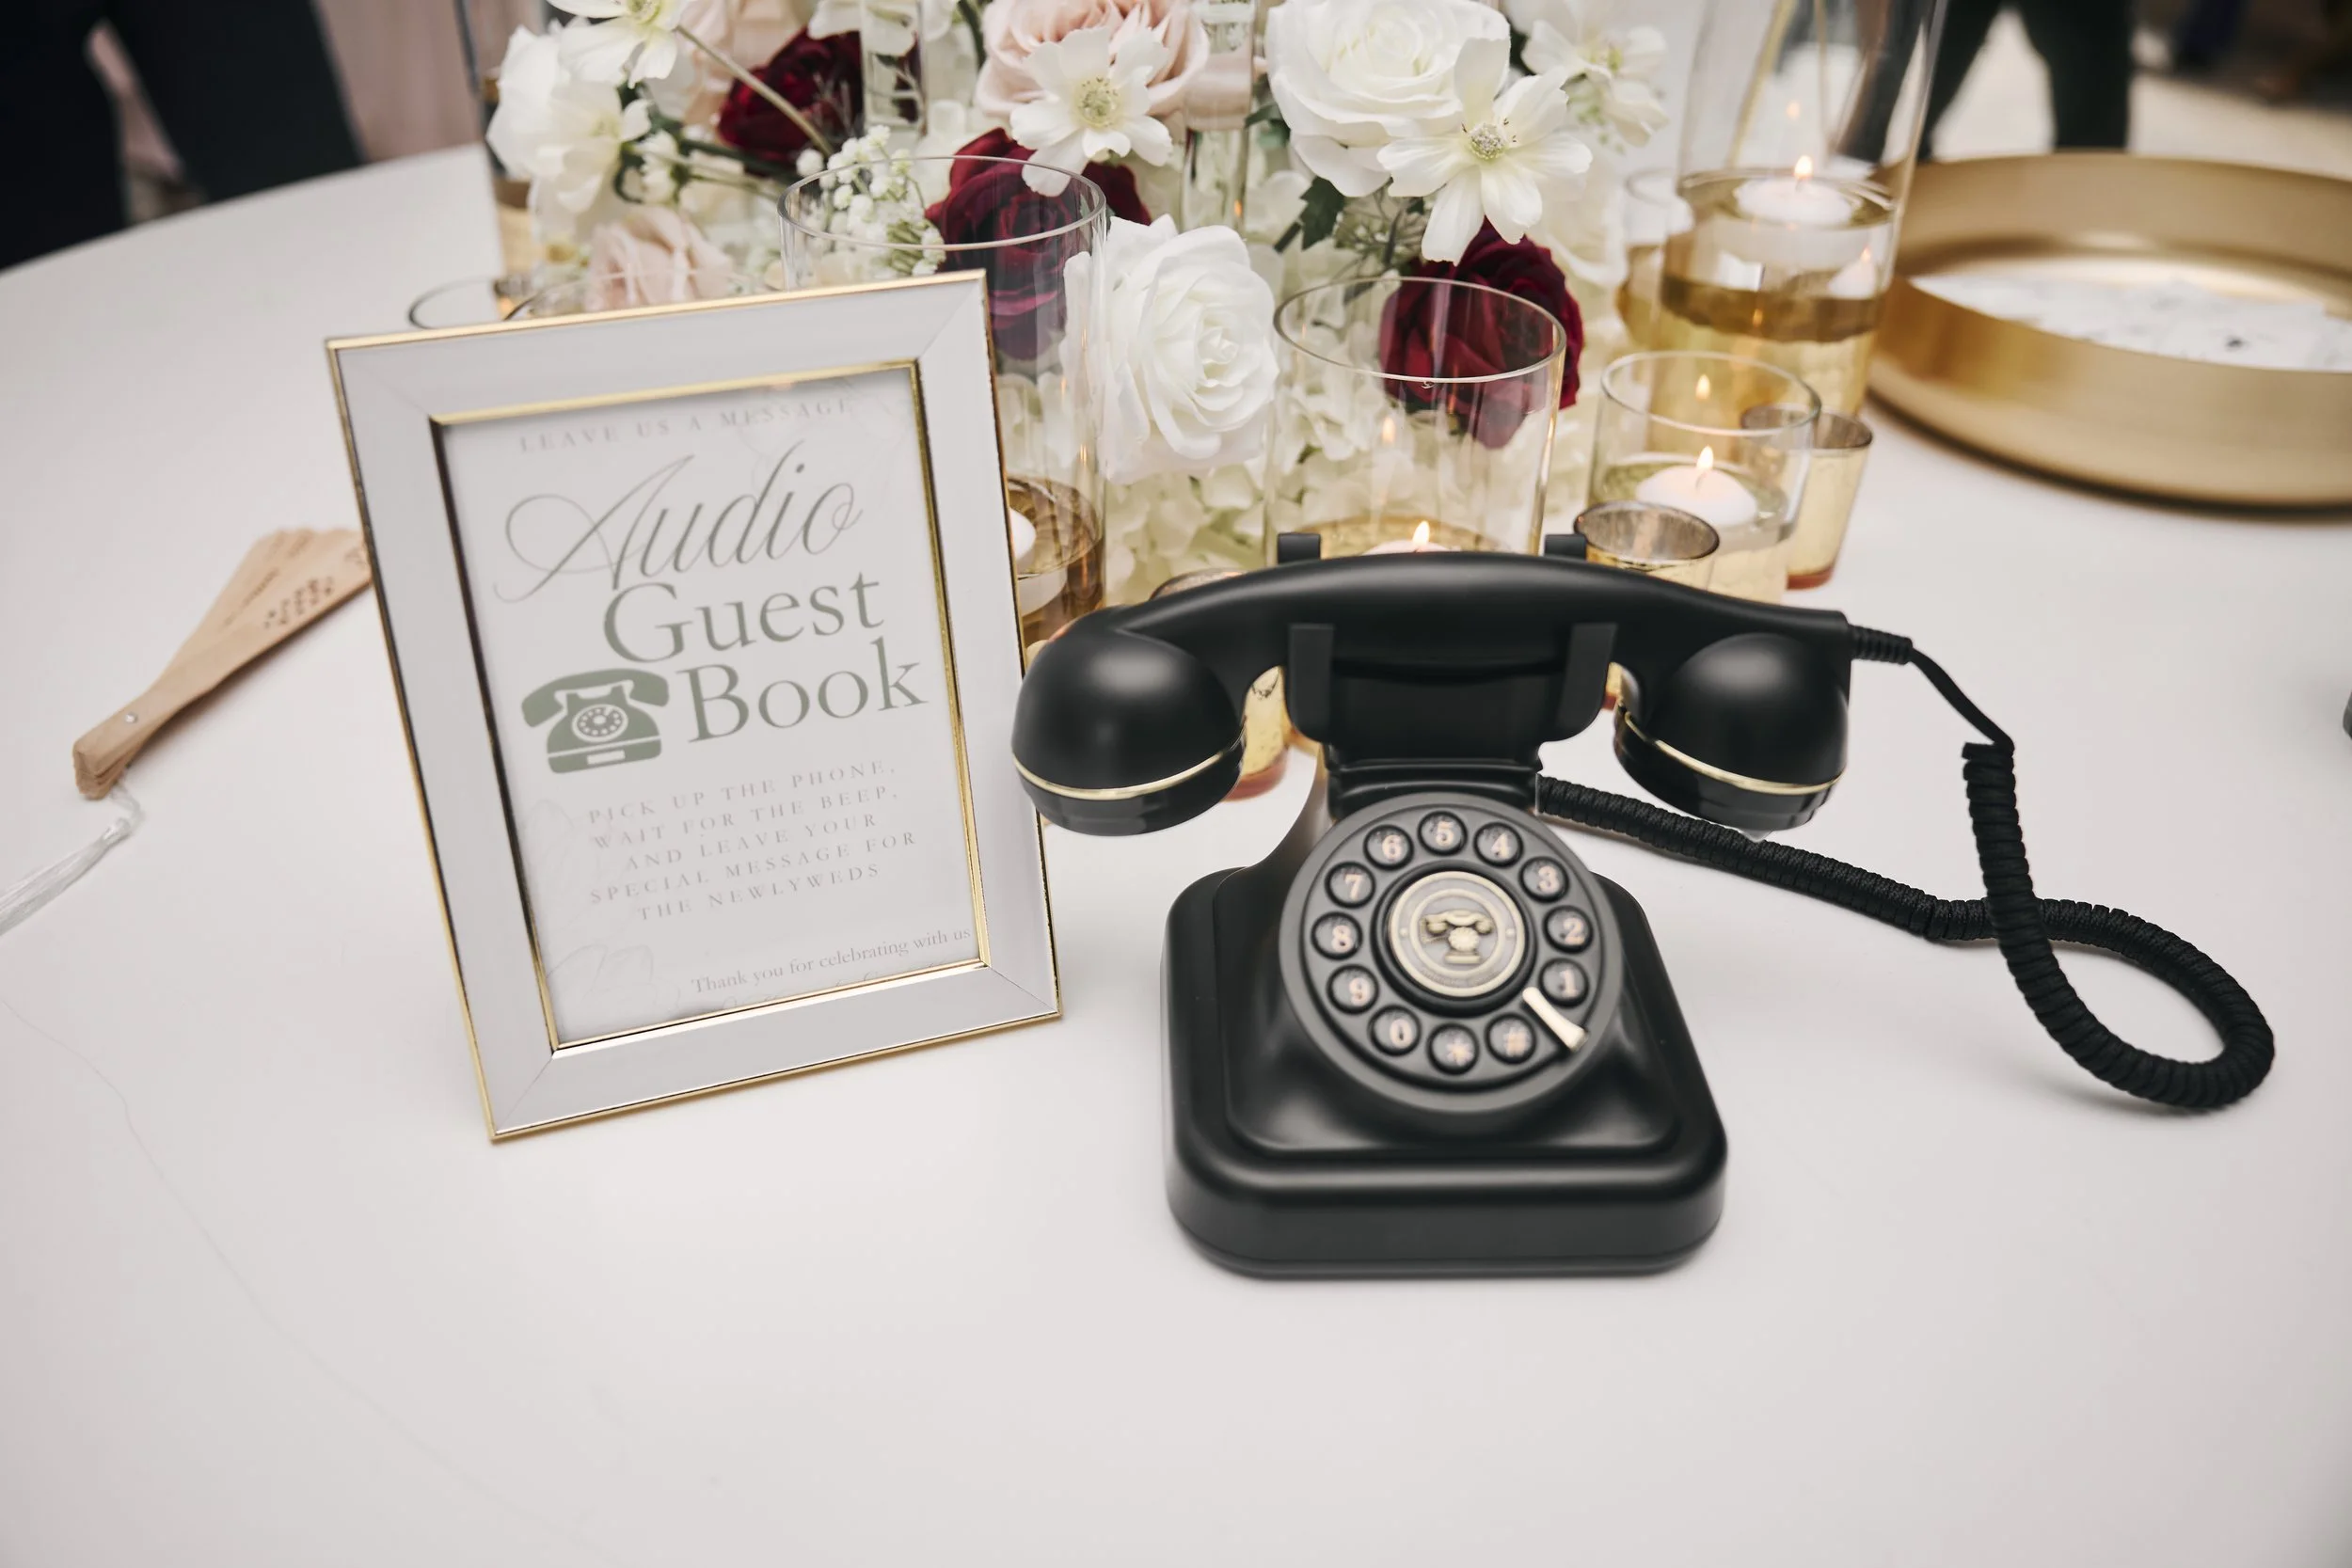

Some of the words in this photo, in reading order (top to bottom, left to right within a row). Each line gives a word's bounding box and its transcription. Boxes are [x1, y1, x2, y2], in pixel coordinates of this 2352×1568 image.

[520, 424, 619, 452] LEAVE
[637, 420, 670, 438] US
[689, 415, 702, 433] A
[720, 398, 851, 429] MESSAGE
[494, 438, 864, 603] Audio
[603, 572, 885, 662] Guest
[675, 636, 930, 743] Book
[588, 800, 657, 825] PICK
[673, 791, 706, 810] UP
[721, 779, 776, 801] THE
[790, 759, 896, 789] PHONE,
[593, 825, 664, 850] WAIT
[682, 813, 735, 835] FOR
[750, 800, 804, 823] THE
[820, 784, 898, 810] BEEP,
[1435, 820, 1455, 846] 5
[626, 847, 683, 872] AND
[700, 829, 789, 859] LEAVE
[803, 813, 877, 839] YOUR
[1380, 833, 1403, 861] 6
[1491, 832, 1512, 860] 4
[590, 870, 709, 906] SPECIAL
[724, 839, 850, 879] MESSAGE
[866, 832, 916, 853] FOR
[1344, 873, 1363, 901] 7
[1537, 864, 1560, 894] 3
[637, 898, 692, 922] THE
[707, 863, 880, 908] NEWLYWEDS
[1331, 925, 1352, 954] 8
[1563, 916, 1585, 945] 2
[691, 969, 748, 994] Thank
[753, 965, 785, 987] you
[789, 958, 815, 975] for
[818, 942, 910, 970] celebrating
[913, 929, 948, 950] with
[953, 927, 972, 942] us
[1348, 976, 1370, 1006] 9
[1559, 969, 1579, 999] 1
[1389, 1018, 1412, 1049] 0
